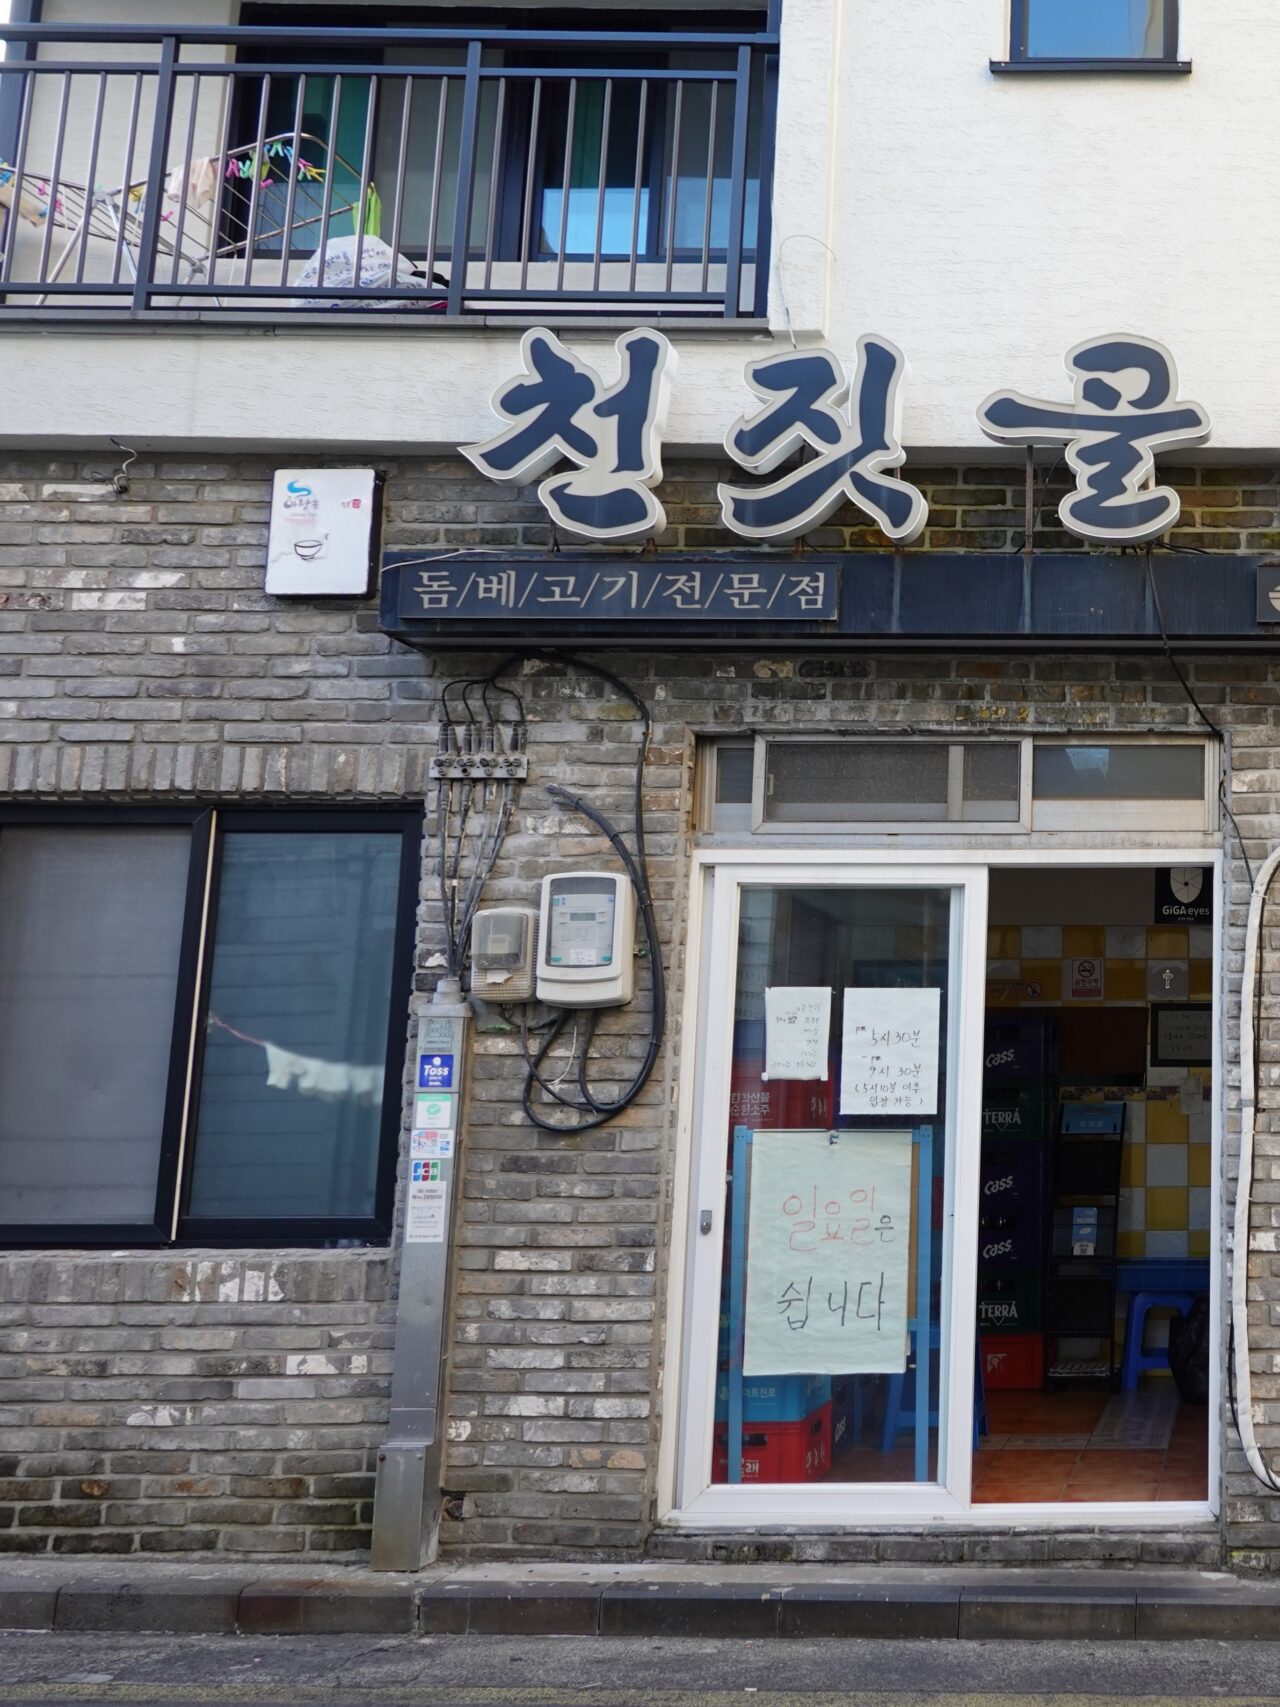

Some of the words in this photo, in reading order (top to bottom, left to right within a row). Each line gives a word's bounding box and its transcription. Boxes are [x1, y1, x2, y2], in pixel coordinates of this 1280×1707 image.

[468, 331, 1206, 536] 천짓골
[1188, 907, 1210, 917] eyes
[985, 1048, 1015, 1068] Cass
[424, 1064, 450, 1076] Toss
[983, 1108, 1022, 1125] TERRA
[984, 1175, 1014, 1195] Cass
[781, 1183, 895, 1252] 일요일은
[982, 1240, 1012, 1259] Cass
[777, 1271, 886, 1331] 쉽니다
[979, 1300, 1018, 1319] TERRA
